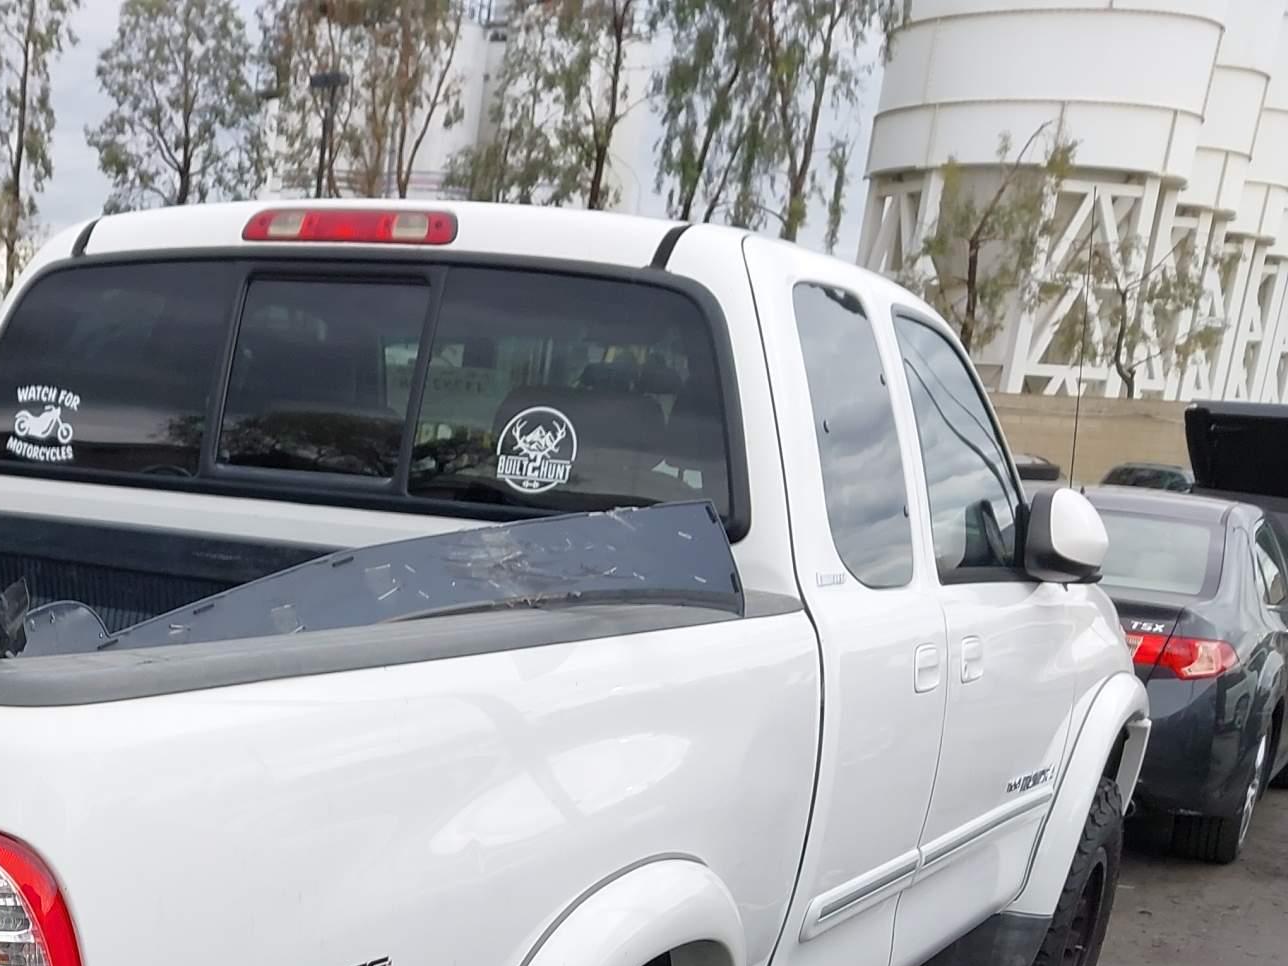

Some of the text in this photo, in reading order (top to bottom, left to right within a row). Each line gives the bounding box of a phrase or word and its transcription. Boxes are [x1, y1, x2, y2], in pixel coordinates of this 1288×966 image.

[16, 385, 81, 411] WATCH FOR
[6, 436, 74, 462] MOTORCYCLES
[1130, 620, 1165, 632] TSX
